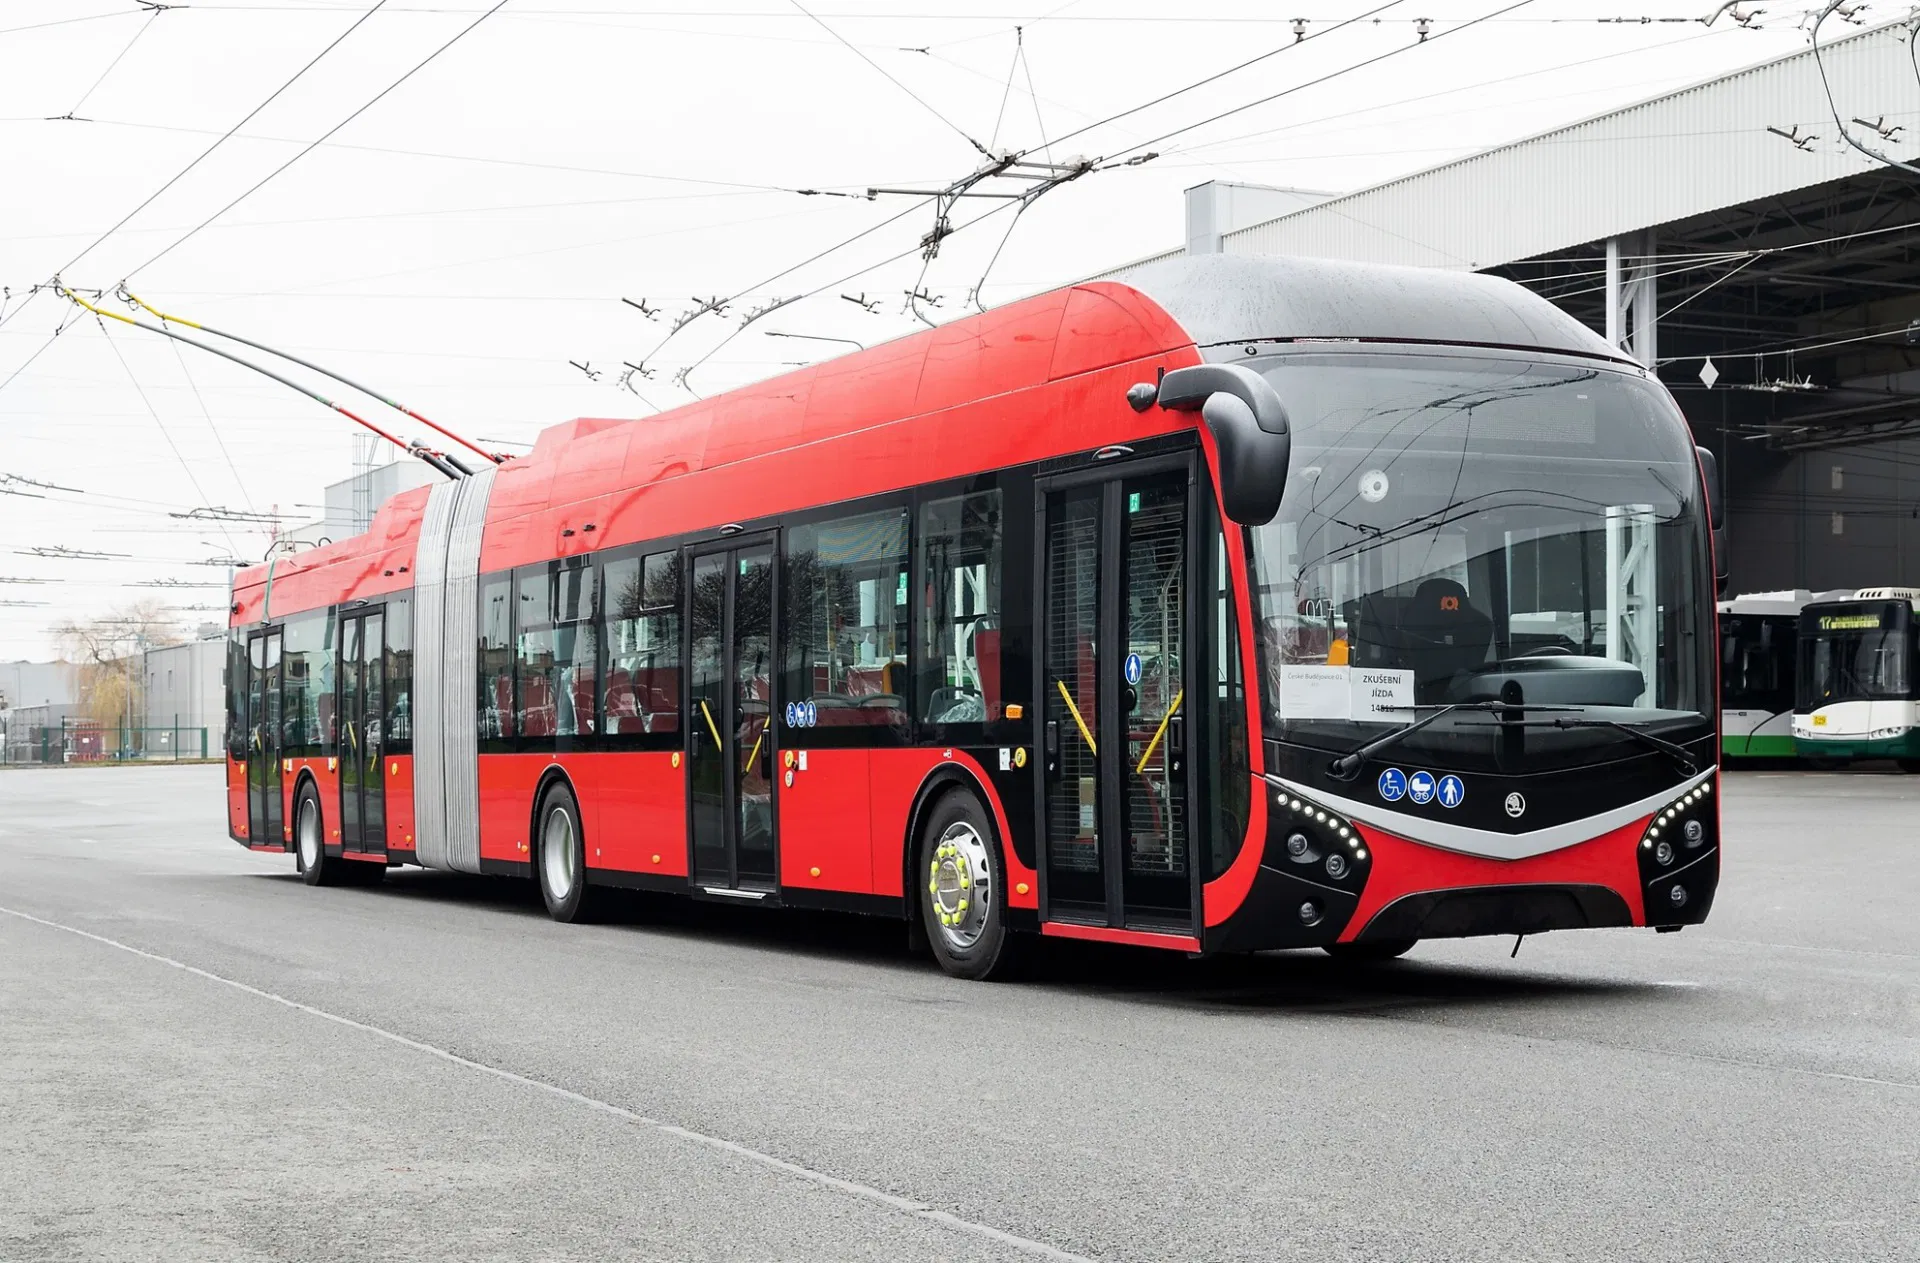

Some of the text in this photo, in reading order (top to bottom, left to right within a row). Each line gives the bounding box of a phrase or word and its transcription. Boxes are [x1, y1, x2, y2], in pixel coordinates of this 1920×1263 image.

[1306, 599, 1334, 621] 017
[1363, 674, 1401, 684] ZKUŠEBNÍ
[1372, 688, 1393, 697] JÍZDA
